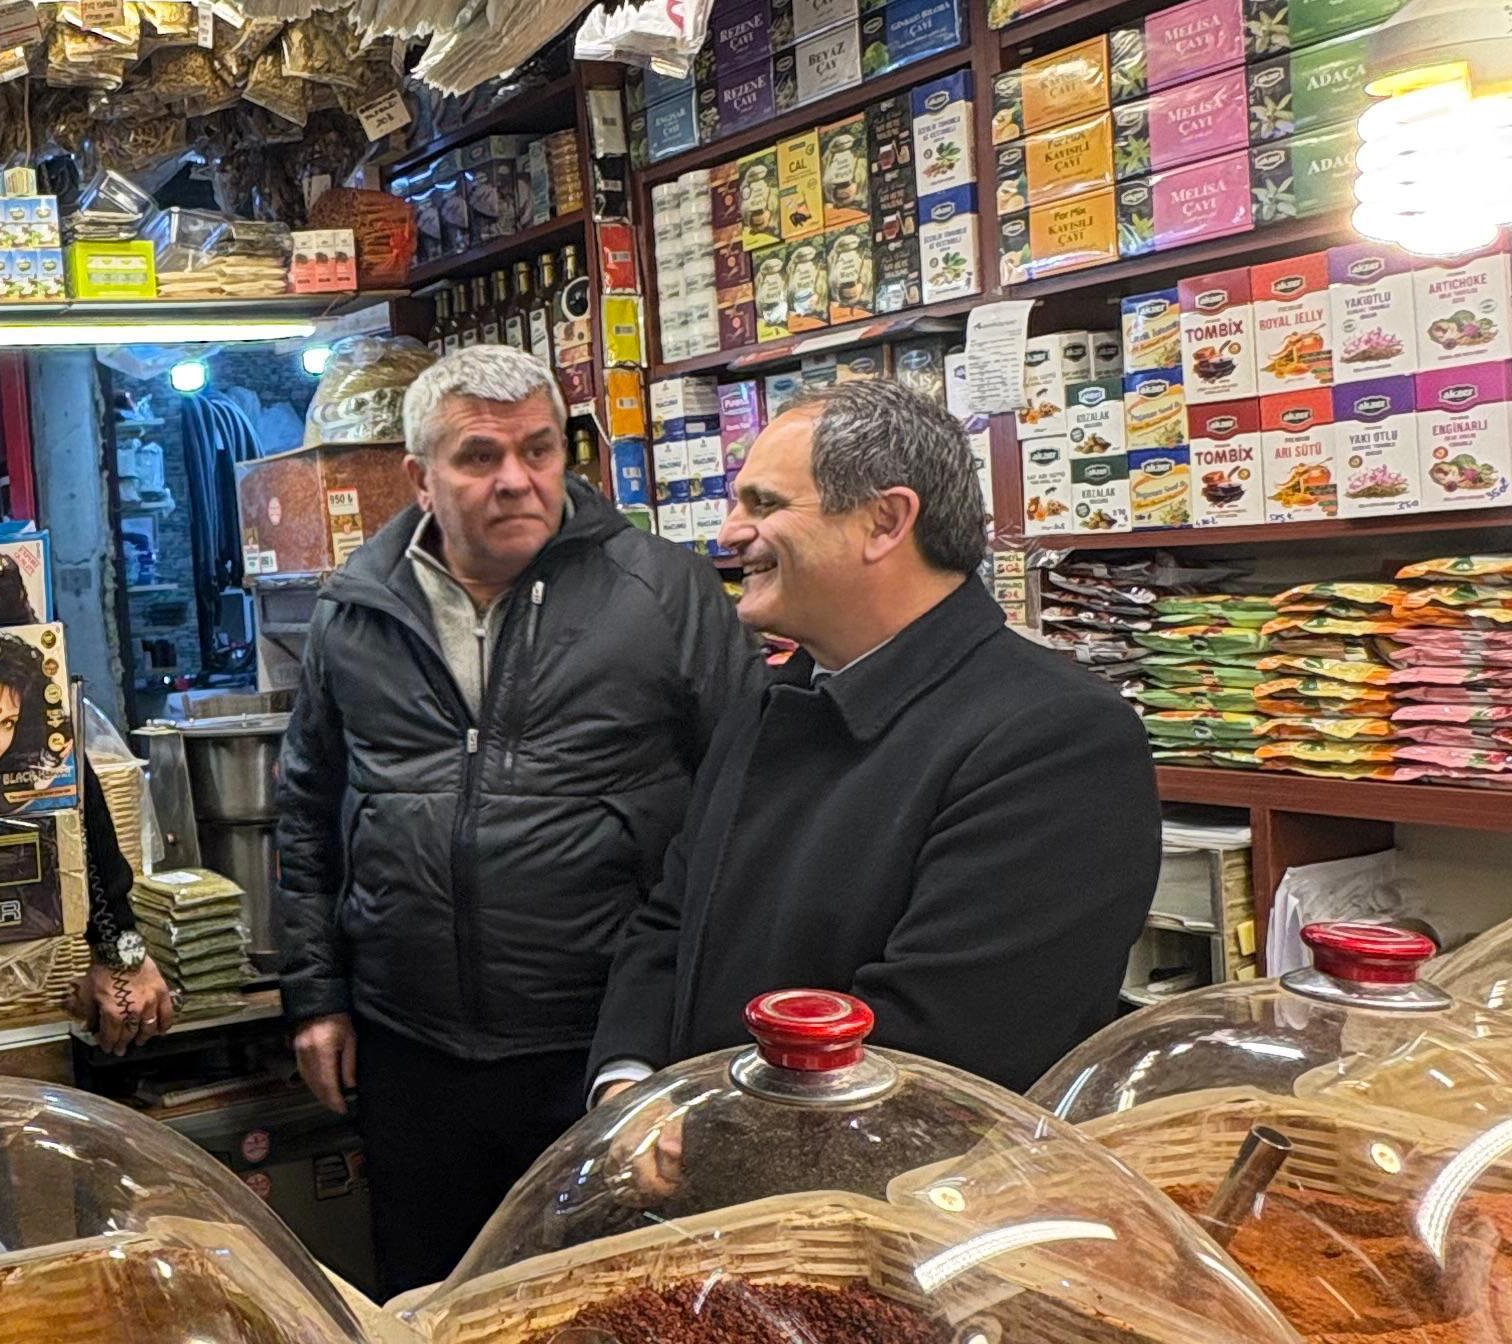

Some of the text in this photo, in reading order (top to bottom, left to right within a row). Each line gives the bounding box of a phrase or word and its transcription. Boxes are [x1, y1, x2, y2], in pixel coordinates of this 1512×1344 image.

[720, 13, 764, 43] REZENE
[1164, 14, 1223, 43] MELİSA
[808, 42, 845, 67] BEYAZ
[1175, 33, 1213, 56] ÇAYI
[816, 59, 838, 76] ÇAY
[1306, 63, 1367, 91] ADAÇA
[723, 75, 767, 103] REZENE
[1167, 100, 1223, 125] MELİSA
[1178, 115, 1213, 136] ÇAYI
[1045, 142, 1090, 163] KAYISILI
[1054, 158, 1081, 173] ÇAYI
[1307, 152, 1354, 175] ADAÇ
[1170, 179, 1227, 205] MELİSA
[1181, 197, 1217, 217] ÇAYI
[1047, 218, 1094, 237] KAYISILI
[1057, 232, 1085, 246] ÇAYI
[1429, 273, 1487, 294] ARTICHOKE
[1185, 318, 1244, 343] TOMBİX
[1259, 309, 1324, 331] ROYAL JELLY
[1076, 412, 1110, 424] KOZALAK
[1432, 419, 1488, 437] ENGİNARLI
[1349, 430, 1398, 445] YAKI OTLU
[1194, 445, 1253, 466] TOMBİX
[1275, 442, 1322, 459] ARI SÜTÜ
[1082, 489, 1115, 499] KOZALAK
[3, 772, 35, 785] BLACK
